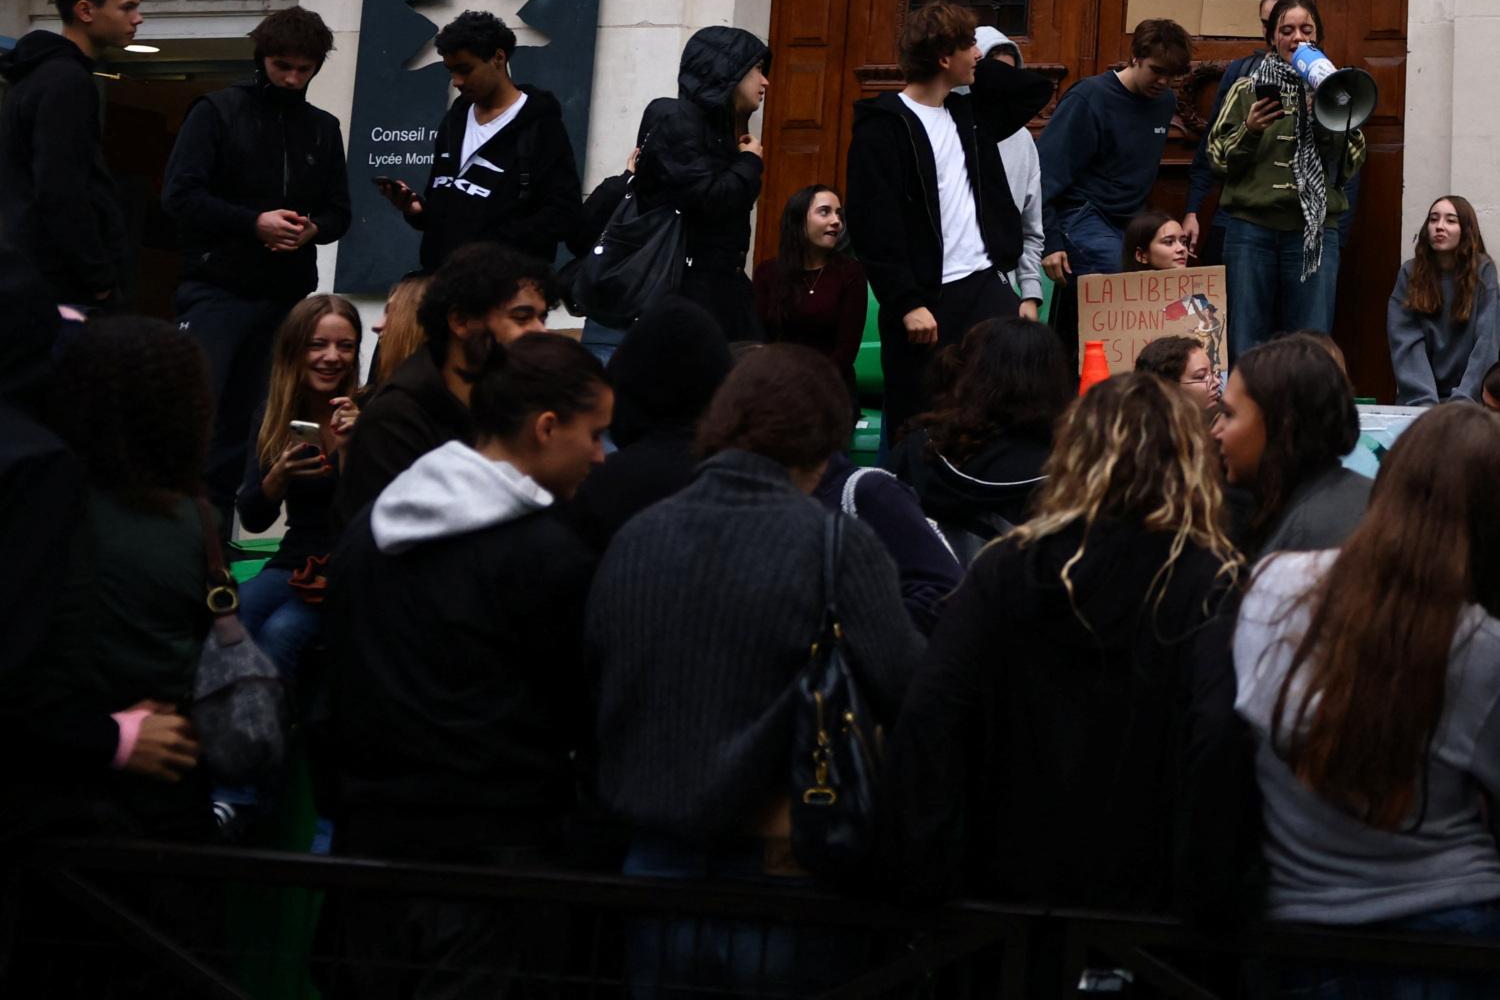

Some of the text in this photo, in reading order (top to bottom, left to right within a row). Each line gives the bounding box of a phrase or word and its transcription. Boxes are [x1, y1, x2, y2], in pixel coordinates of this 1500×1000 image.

[371, 127, 425, 142] Conseil
[368, 153, 435, 168] Lycée Mont
[1084, 279, 1113, 304] LA
